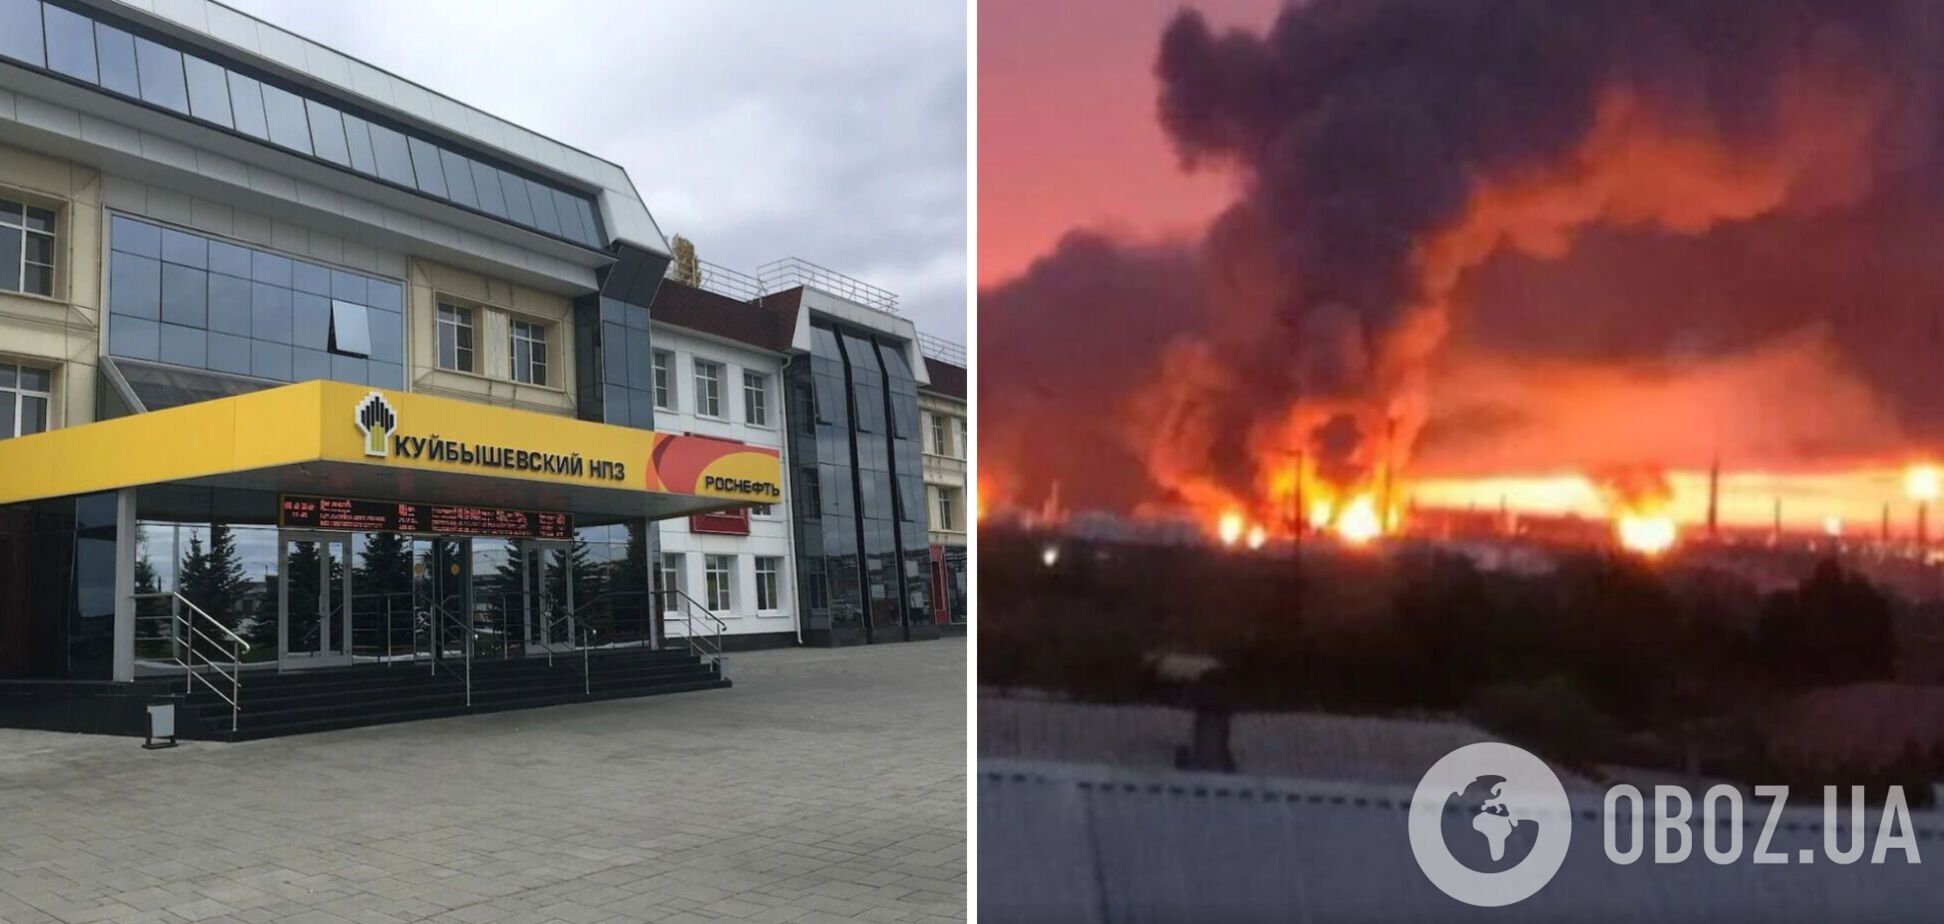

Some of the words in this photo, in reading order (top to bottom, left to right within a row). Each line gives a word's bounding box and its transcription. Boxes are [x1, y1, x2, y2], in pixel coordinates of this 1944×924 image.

[394, 434, 583, 477] КУЙБЫШЕВСКИЙ
[590, 459, 626, 481] НПЗ
[705, 475, 780, 497] РОСНЕФТЬ
